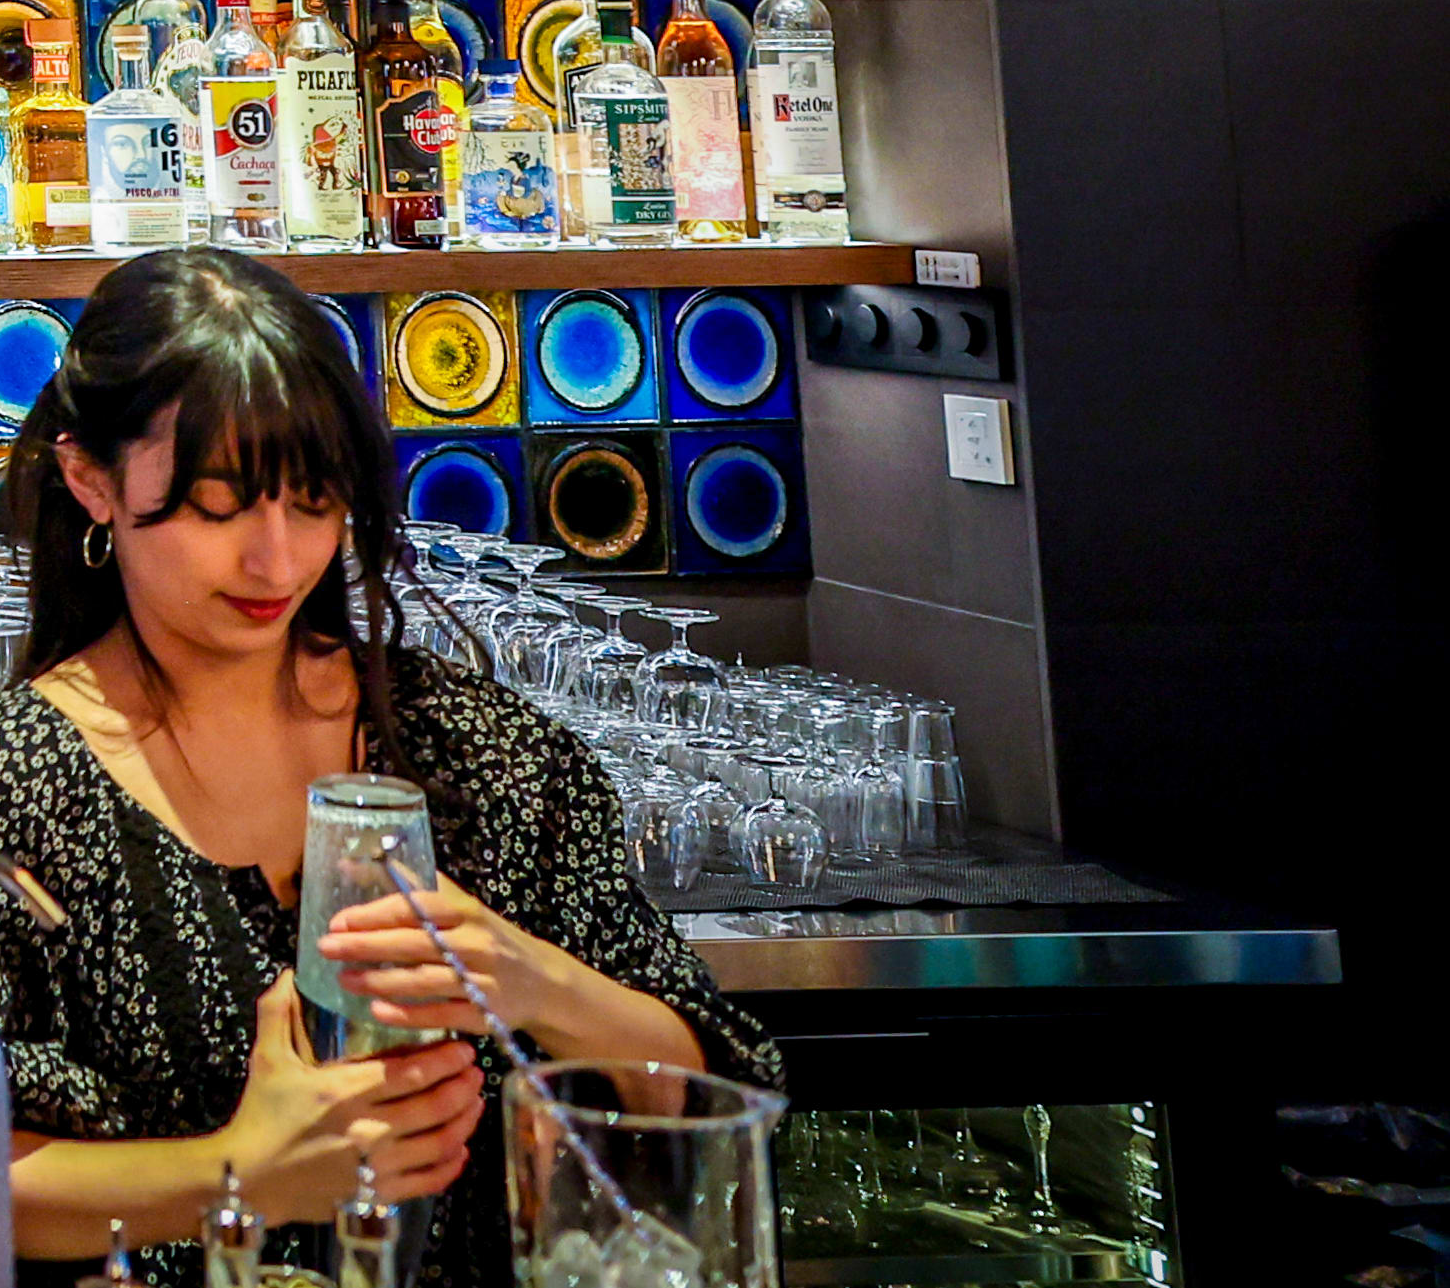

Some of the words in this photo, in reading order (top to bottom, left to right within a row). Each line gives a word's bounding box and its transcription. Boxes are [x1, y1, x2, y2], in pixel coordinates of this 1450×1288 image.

[237, 110, 269, 137] 51
[149, 124, 178, 149] 16
[125, 188, 152, 198] PISCO
